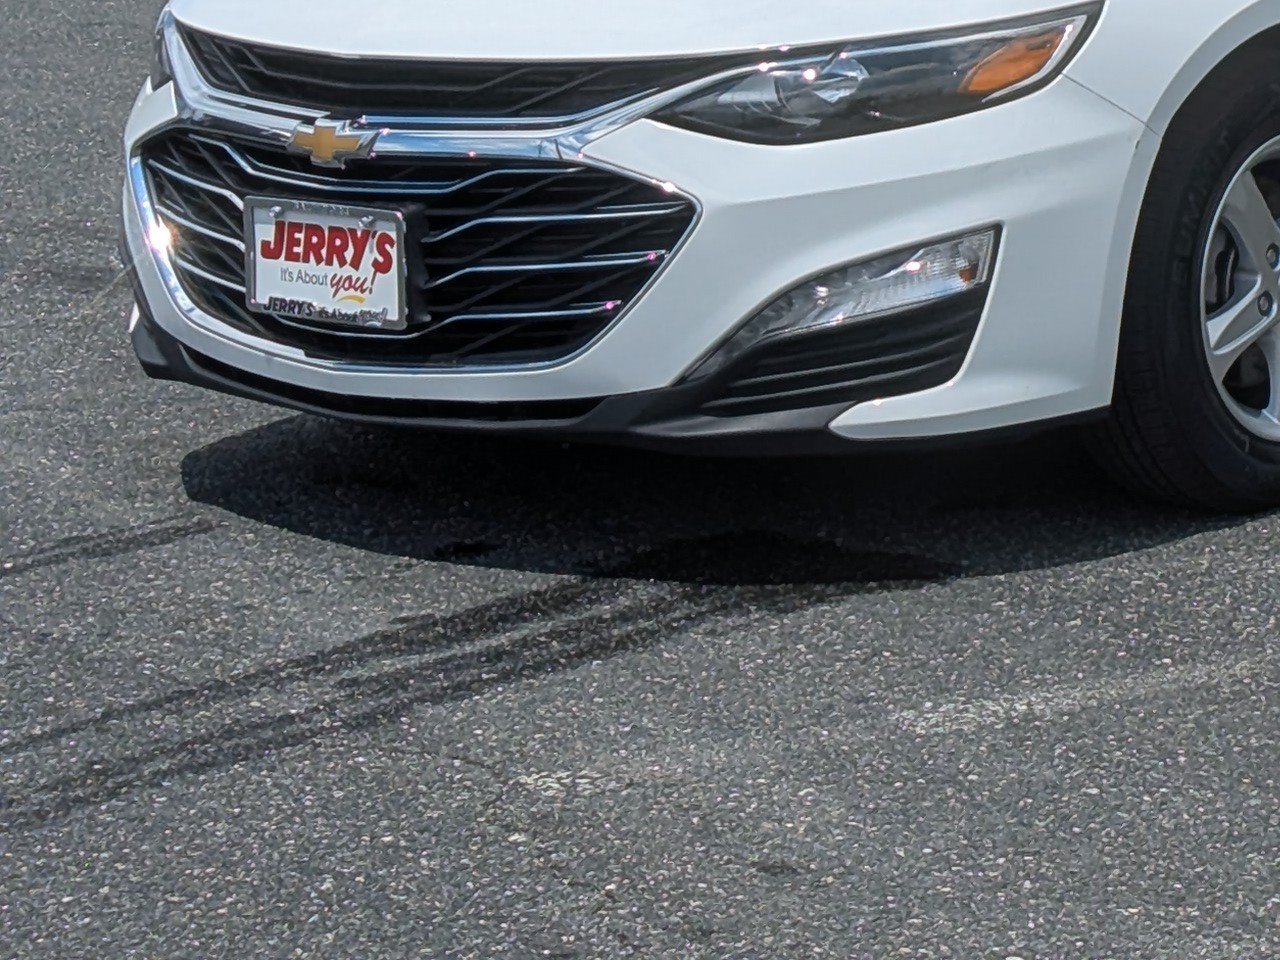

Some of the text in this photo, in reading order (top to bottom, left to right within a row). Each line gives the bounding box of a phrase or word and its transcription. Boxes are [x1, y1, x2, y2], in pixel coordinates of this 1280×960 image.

[260, 220, 396, 274] JERRY'S
[280, 267, 377, 299] It's About you!
[263, 296, 316, 317] JERRY'S
